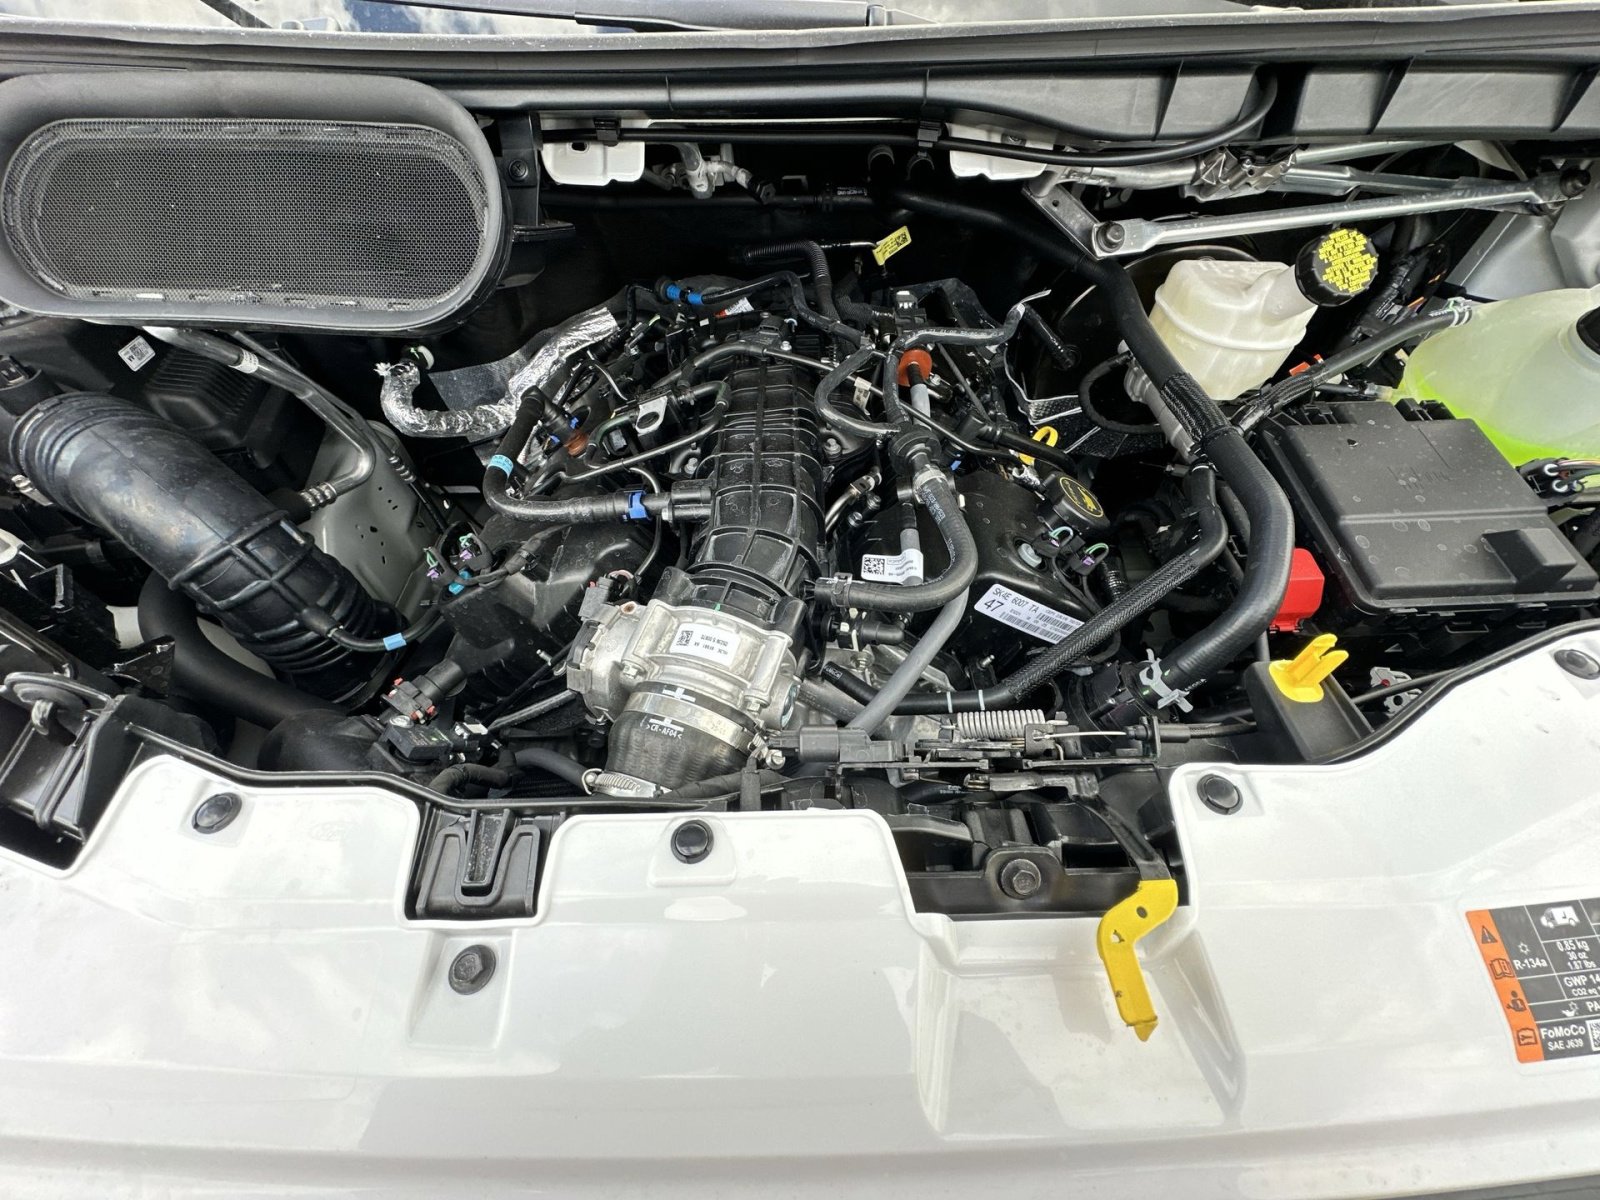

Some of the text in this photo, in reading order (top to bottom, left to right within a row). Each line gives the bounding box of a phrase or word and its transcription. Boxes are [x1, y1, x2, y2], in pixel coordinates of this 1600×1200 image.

[993, 588, 1012, 600] SK4E
[984, 599, 1005, 612] 47
[1556, 939, 1590, 952] 0.85 kg
[1566, 951, 1589, 961] 30 oz
[1512, 957, 1548, 970] R-134a
[1563, 974, 1588, 987] GWP
[1571, 987, 1588, 997] CO2
[1540, 1024, 1586, 1039] FoMoCo
[1547, 1040, 1566, 1051] SAE
